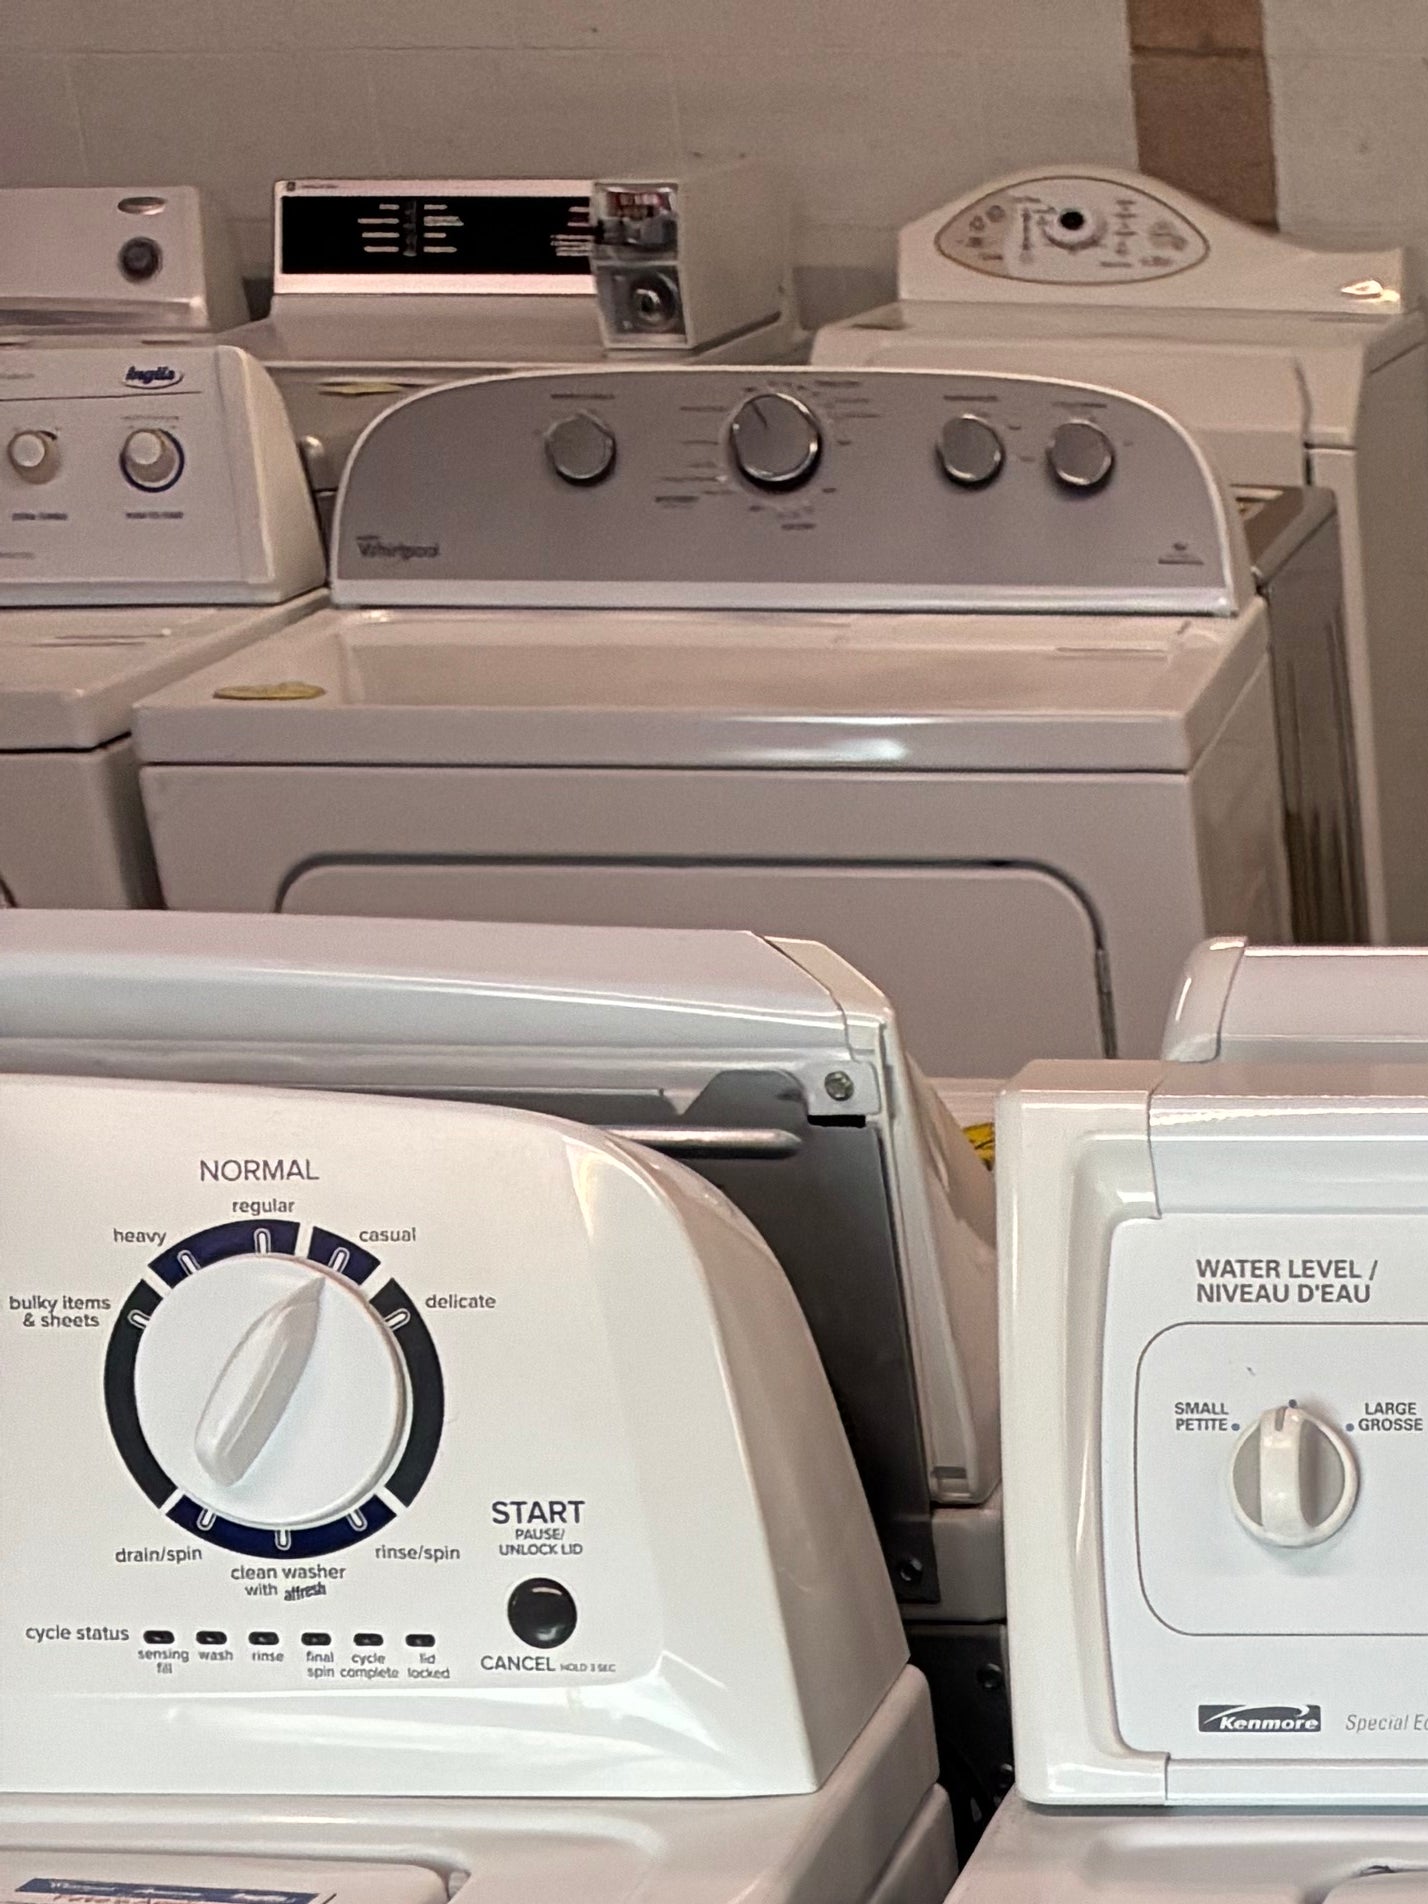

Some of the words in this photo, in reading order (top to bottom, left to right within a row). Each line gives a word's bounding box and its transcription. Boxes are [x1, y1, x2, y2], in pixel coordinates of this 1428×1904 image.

[200, 1159, 320, 1182] NORMAL
[232, 1198, 296, 1216] regular
[113, 1227, 167, 1247] heavy
[358, 1227, 417, 1242] casual
[1196, 1259, 1280, 1279] WATER
[1288, 1259, 1362, 1279] LEVEL
[1196, 1283, 1289, 1303] NIVEAU
[1297, 1283, 1371, 1303] D'EAU
[9, 1295, 57, 1314] bulky
[62, 1295, 111, 1310] items
[425, 1294, 496, 1309] delicate
[22, 1313, 35, 1327] &
[41, 1313, 100, 1327] sheets
[1174, 1402, 1229, 1415] SMALL
[1364, 1402, 1416, 1415] LARGE
[1176, 1418, 1228, 1431] PETITE
[1358, 1418, 1423, 1431] GROSSE
[492, 1500, 586, 1525] START
[515, 1528, 566, 1541] PAUSE/
[115, 1546, 203, 1564] drain/spin
[375, 1545, 461, 1563] rinse/spin
[499, 1543, 558, 1556] UNLOCK
[561, 1543, 583, 1556] LID
[231, 1564, 278, 1580] clean
[282, 1564, 347, 1580] washer
[245, 1583, 278, 1596] with
[26, 1625, 71, 1643] cycle
[77, 1625, 130, 1641] status
[138, 1649, 189, 1662] sensing
[198, 1650, 233, 1661] wash
[252, 1650, 284, 1662] rinse
[306, 1651, 334, 1663] final
[351, 1653, 385, 1665] cycle
[419, 1653, 435, 1664] lid
[480, 1655, 556, 1672] CANCEL
[307, 1666, 335, 1679] spin
[340, 1666, 399, 1679] complete
[408, 1667, 450, 1679] locked
[1219, 1716, 1319, 1730] Kenmore
[1345, 1714, 1409, 1733] Special
